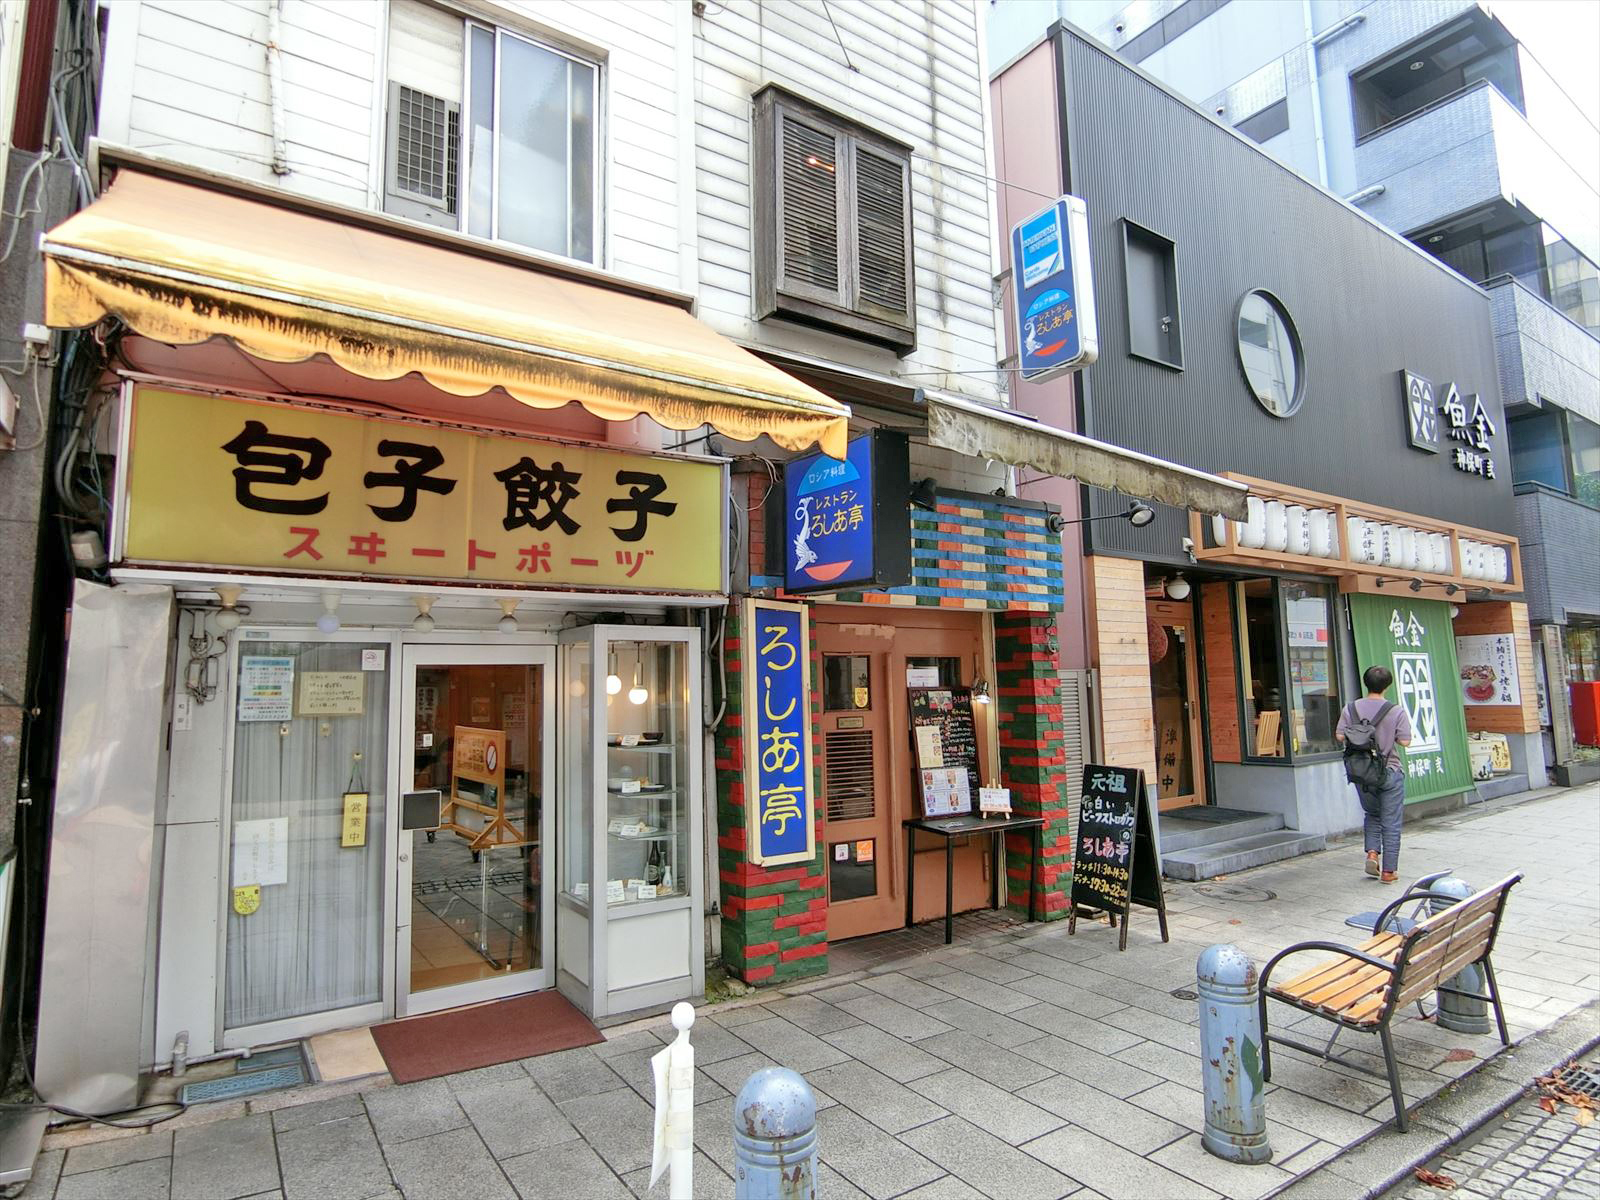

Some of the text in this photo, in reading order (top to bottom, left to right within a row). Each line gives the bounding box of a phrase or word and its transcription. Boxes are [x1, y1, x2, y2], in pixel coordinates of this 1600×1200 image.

[1036, 309, 1074, 336] ろしあ亭
[1037, 303, 1069, 323] レストラン
[1442, 381, 1496, 452] 魚金
[220, 419, 678, 542] 包子餃子
[815, 489, 858, 511] レストラン
[811, 504, 865, 538] ろしあ亭
[283, 526, 655, 578] スヰートポーヅ
[1388, 608, 1425, 647] 魚金
[760, 625, 804, 836] ろしあ亭
[1162, 728, 1178, 793] 準備中
[1090, 770, 1127, 794] 元祖
[1094, 795, 1115, 809] 白い
[349, 801, 362, 843] 営業中
[1082, 837, 1130, 863] ろしあ亭
